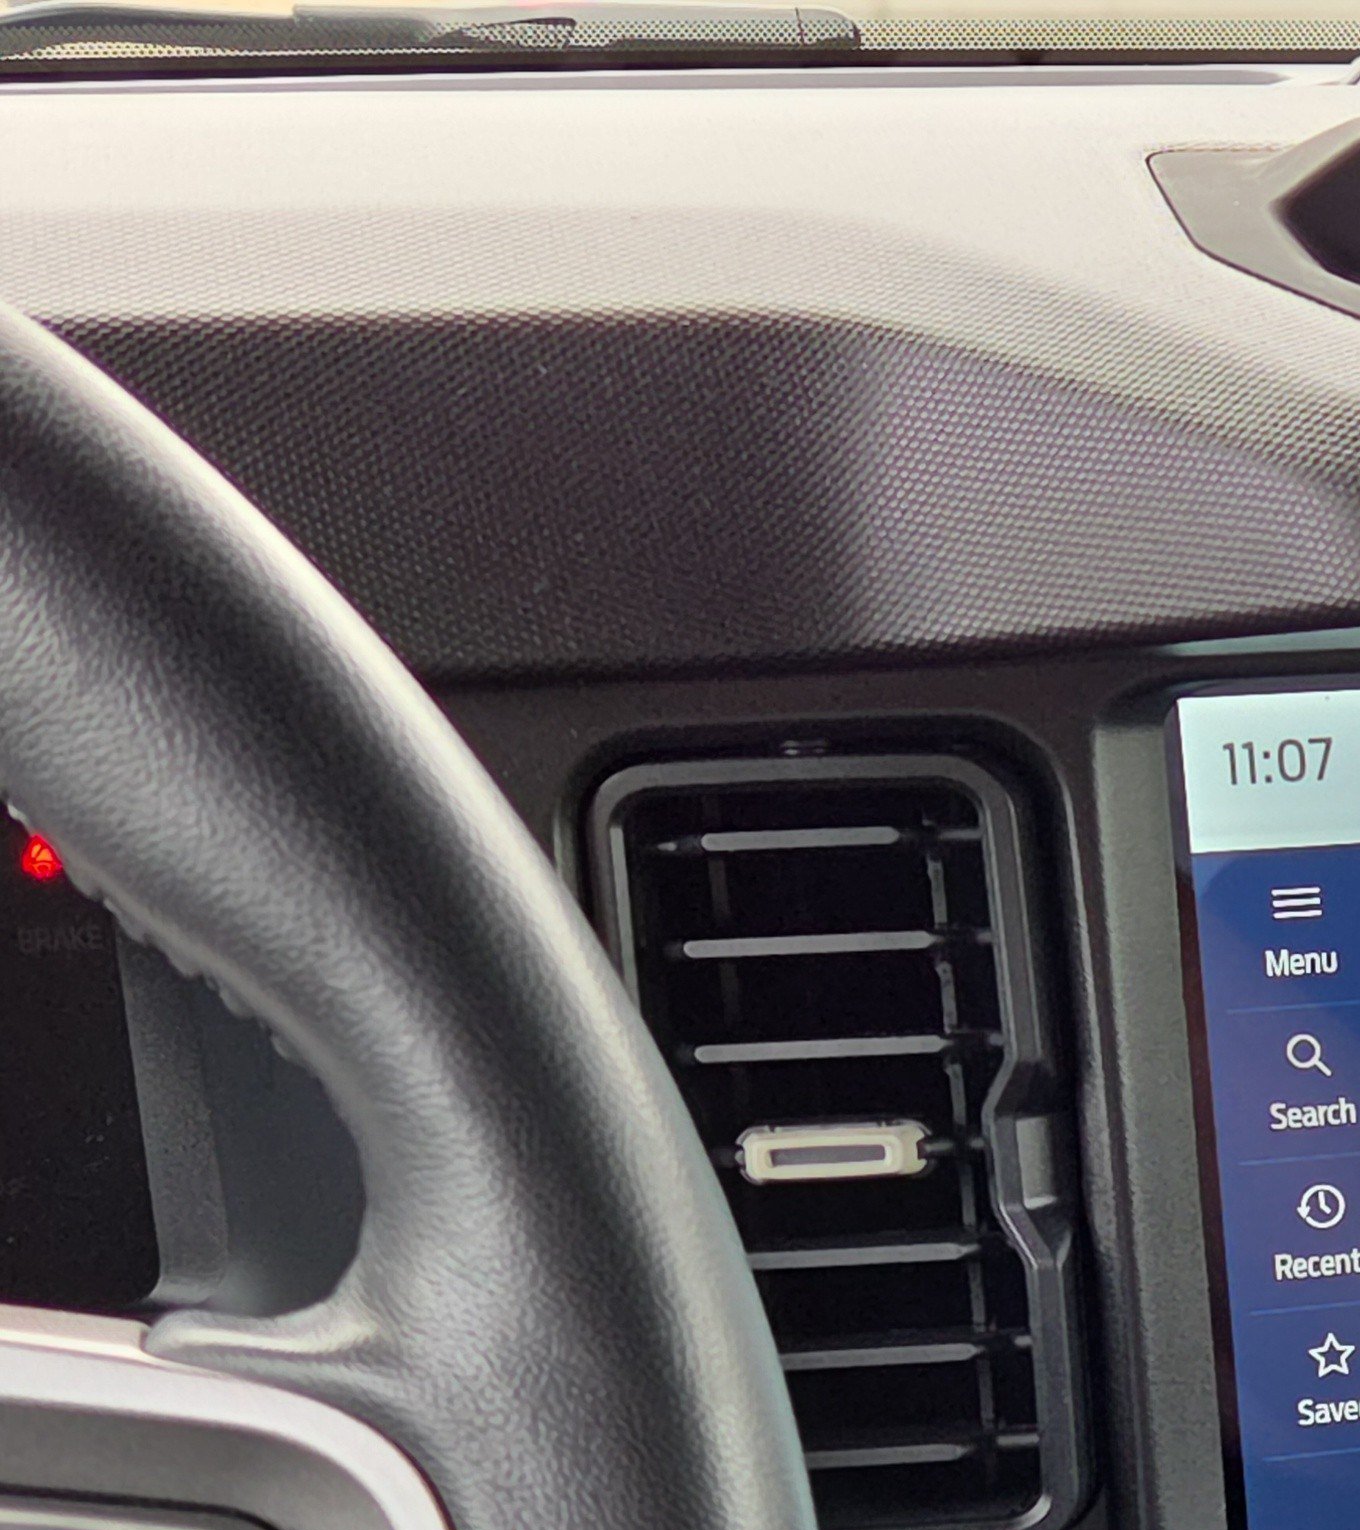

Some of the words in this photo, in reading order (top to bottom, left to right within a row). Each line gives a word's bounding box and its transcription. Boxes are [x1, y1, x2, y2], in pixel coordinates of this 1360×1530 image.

[1222, 737, 1333, 786] 11:07
[1264, 948, 1338, 977] Menu
[1269, 1097, 1357, 1130] Search
